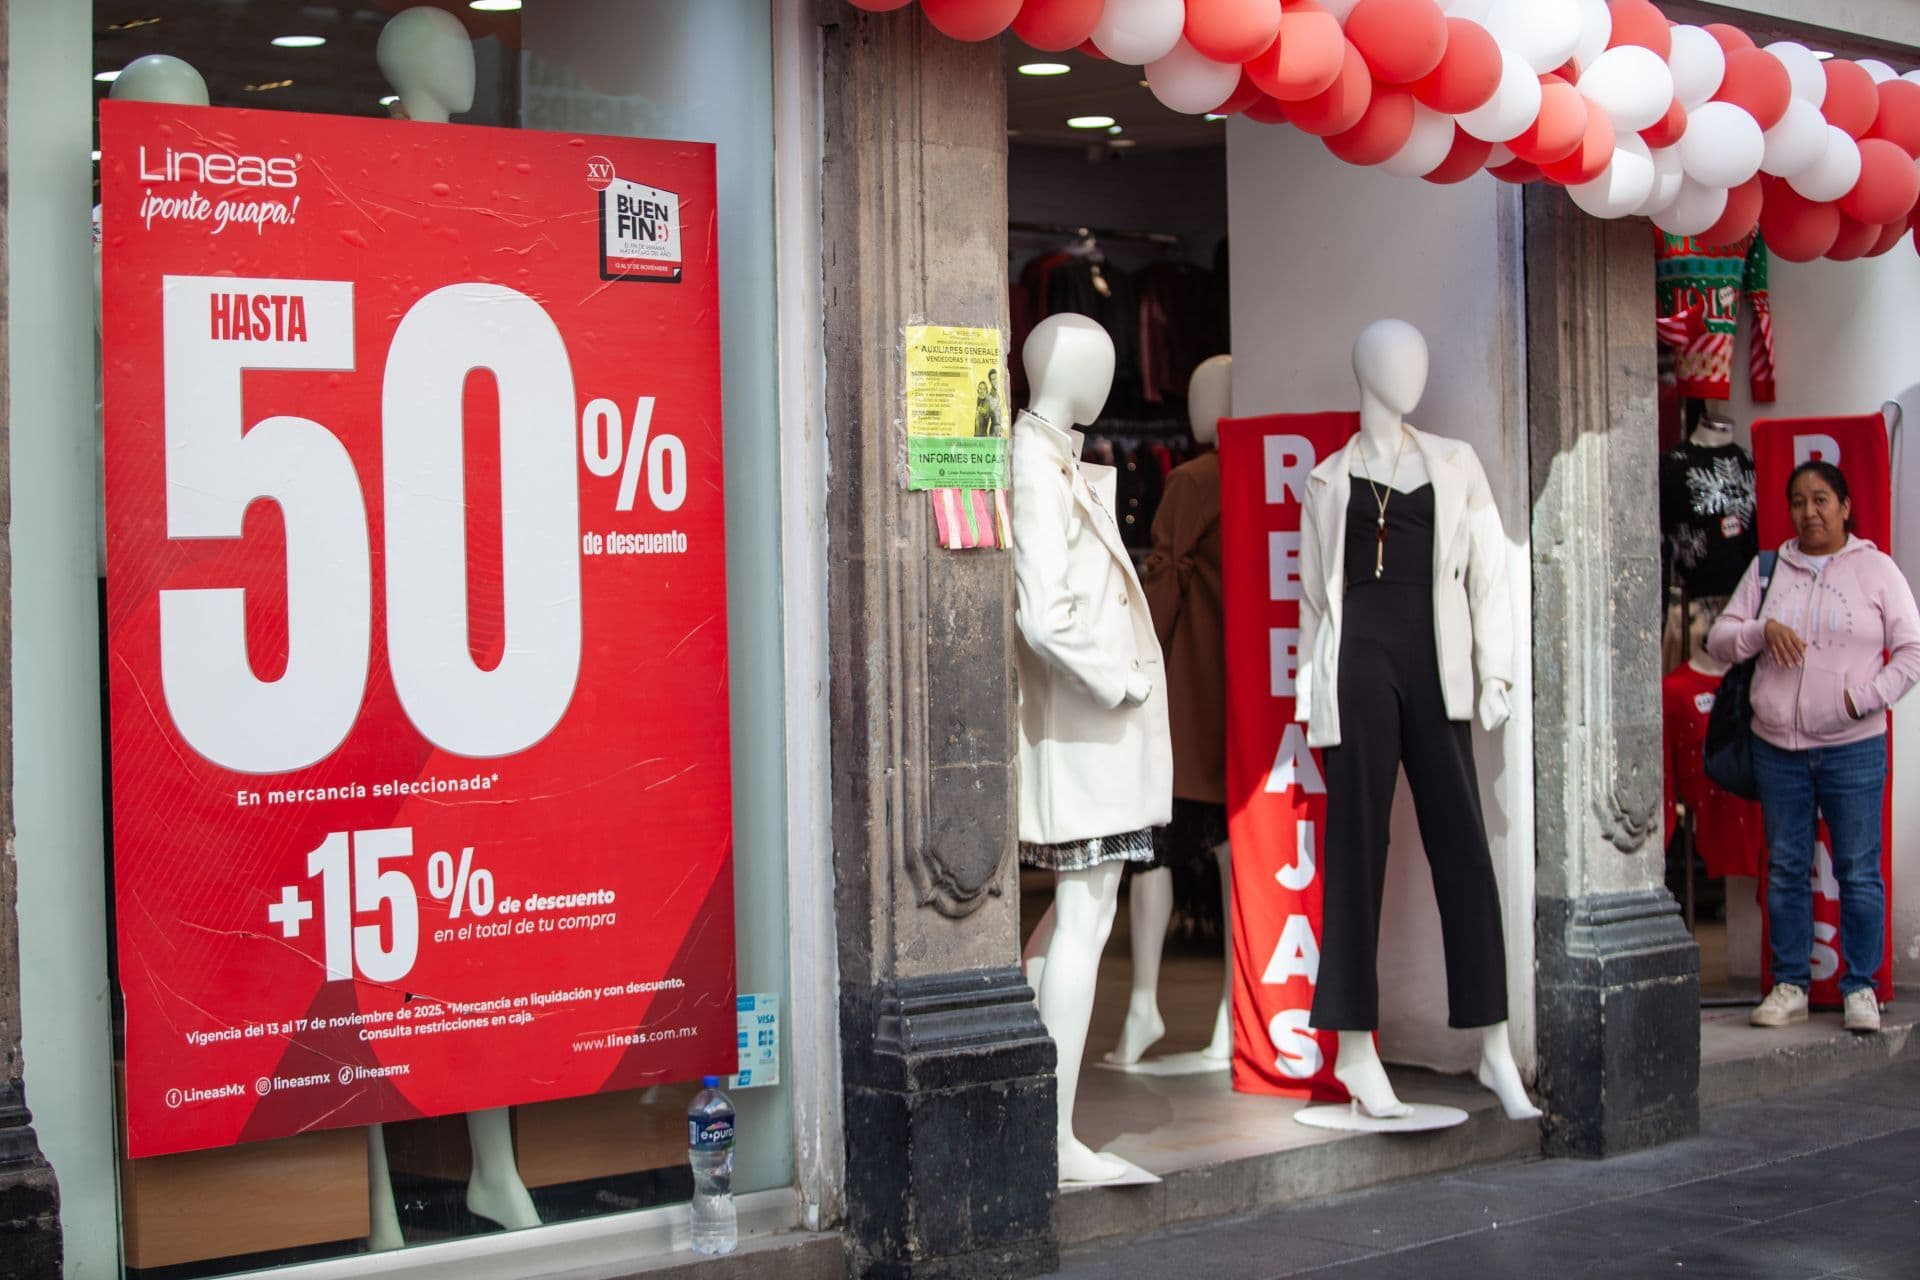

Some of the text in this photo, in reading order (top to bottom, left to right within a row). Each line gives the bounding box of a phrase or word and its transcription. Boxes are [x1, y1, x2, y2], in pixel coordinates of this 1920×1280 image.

[587, 163, 610, 178] XV
[211, 196, 300, 235] guapa!
[617, 194, 669, 222] BUEN
[210, 293, 307, 342] HASTA
[964, 347, 1000, 356] GENERALE
[919, 453, 969, 464] INFORMES
[971, 453, 983, 464] EN
[583, 530, 688, 555] de descuento
[237, 790, 261, 806] En
[268, 782, 366, 804] mercancía
[498, 888, 616, 915] de descuento
[434, 911, 616, 943] en el total de tu compra
[186, 1030, 242, 1046] Vigencia
[246, 1024, 264, 1037] del
[267, 1023, 279, 1035] 13
[282, 1021, 293, 1034] al
[296, 1019, 307, 1032] 17
[311, 1017, 326, 1030] de
[329, 1010, 394, 1028] noviembre
[397, 1008, 412, 1020] de
[415, 1004, 445, 1018] 2025.
[514, 996, 529, 1007] en
[530, 987, 592, 1006] liquidación
[594, 988, 602, 1000] y
[604, 984, 624, 997] con
[626, 977, 685, 994] descuento.
[757, 1014, 776, 1025] VISA
[358, 1011, 535, 1042] Consulta restricciones en caja.
[572, 1025, 699, 1053] www.lineas.com.mx
[184, 1063, 411, 1103] LineasMx lineasmx lineasmx
